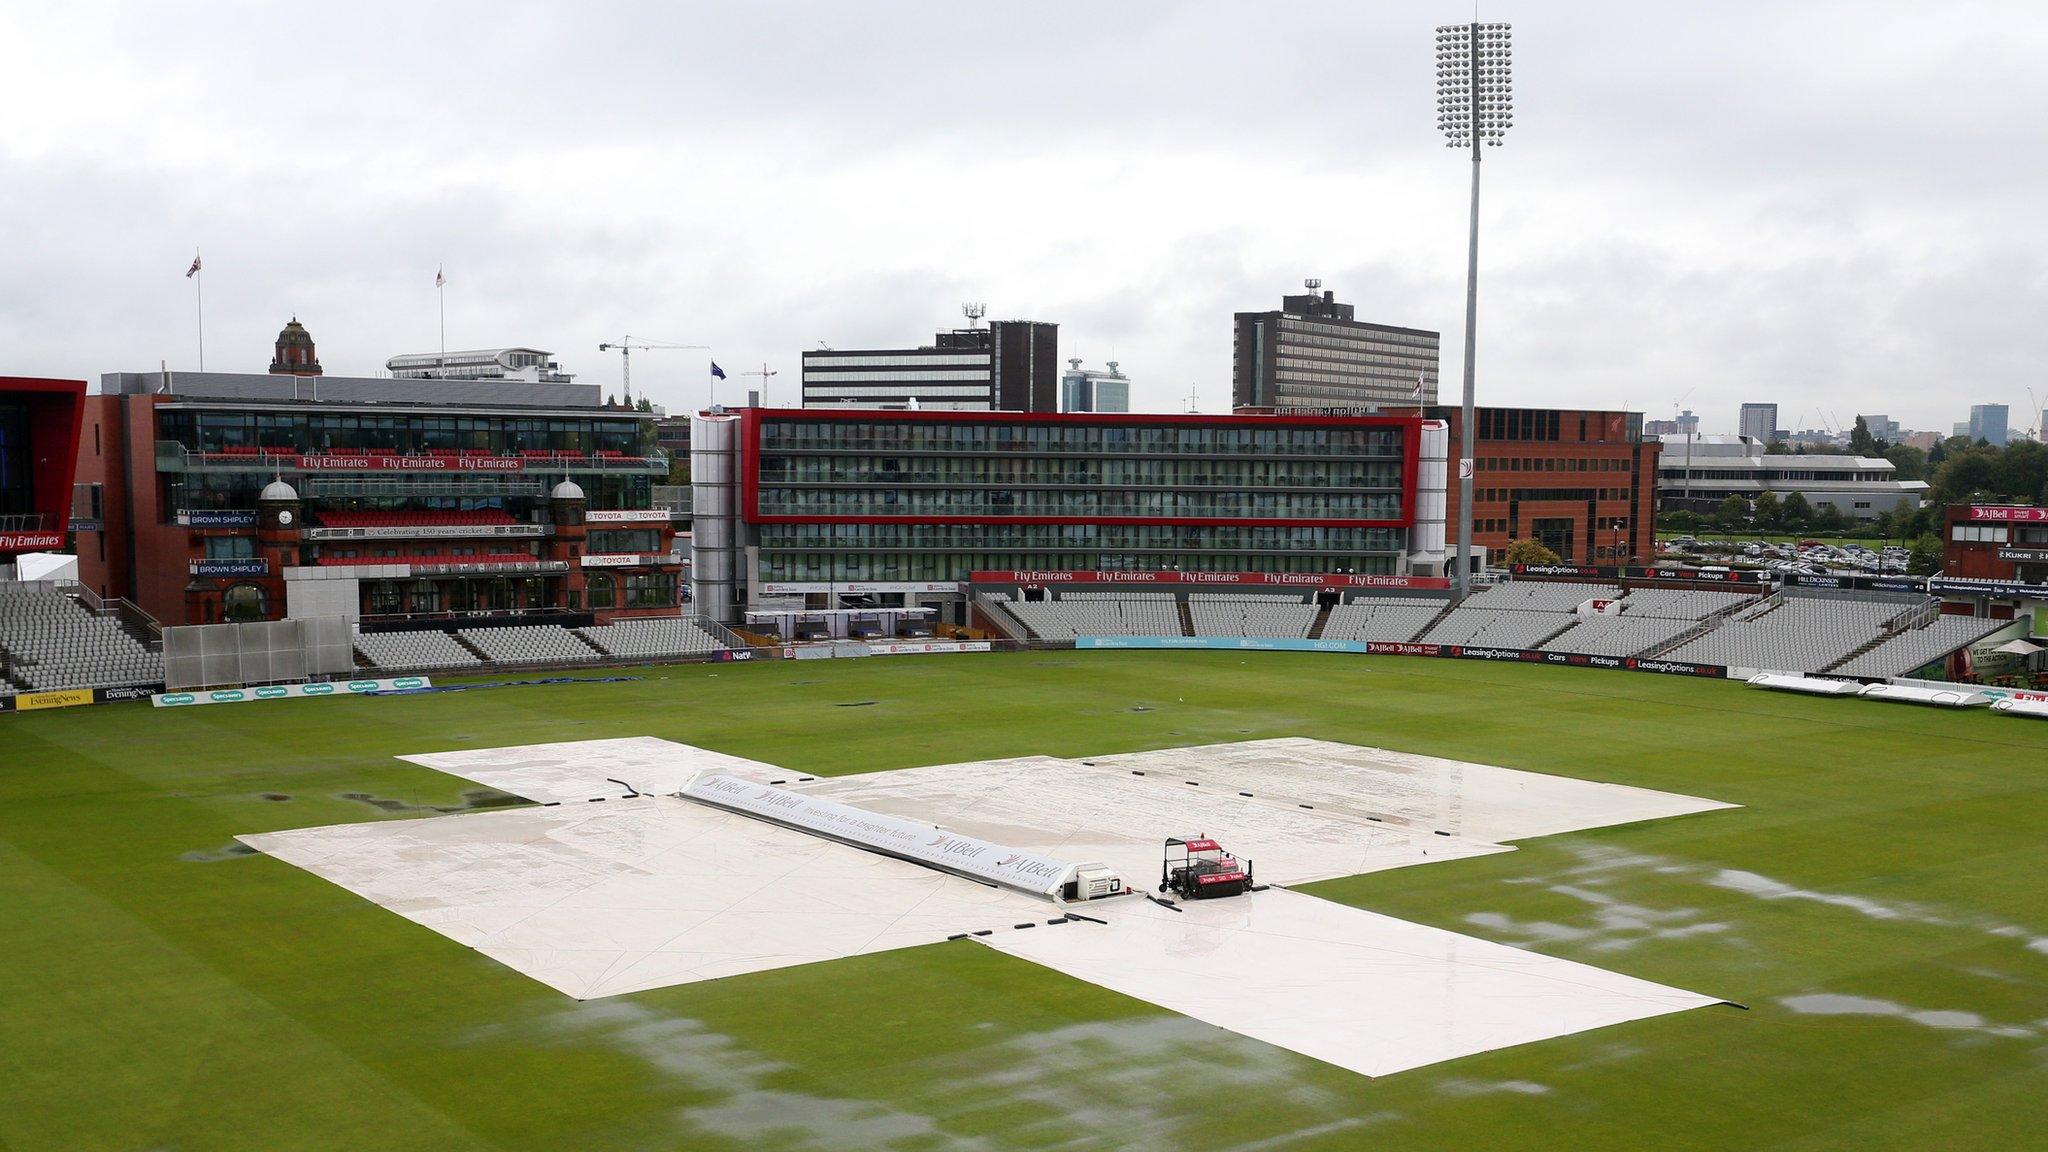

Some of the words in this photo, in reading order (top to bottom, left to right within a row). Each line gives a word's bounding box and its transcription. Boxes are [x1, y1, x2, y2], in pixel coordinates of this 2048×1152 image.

[303, 457, 320, 470] Fly
[324, 458, 368, 468] Emirates
[383, 458, 400, 470] Fly
[402, 458, 445, 468] Emirates
[459, 458, 475, 470] Fly
[477, 458, 518, 468] Emirates
[1983, 510, 2008, 519] AJBell
[0, 536, 16, 548] Fly
[17, 535, 59, 546] Emirates
[1014, 572, 1030, 582] Fly
[1033, 572, 1072, 581] Emirates
[1096, 572, 1112, 583] Fly
[1114, 572, 1155, 581] Emirates
[1180, 572, 1196, 583] Fly
[1199, 572, 1240, 582] Emirates
[1264, 574, 1281, 585] Fly
[1283, 574, 1324, 583] Emirates
[1349, 576, 1366, 586] Fly
[1366, 576, 1408, 586] Emirates
[1698, 572, 1723, 580] Pickups
[1591, 657, 1619, 666] Pickups
[857, 821, 890, 834] brighter
[938, 839, 987, 858] AJBell
[1010, 858, 1062, 878] AJBell
